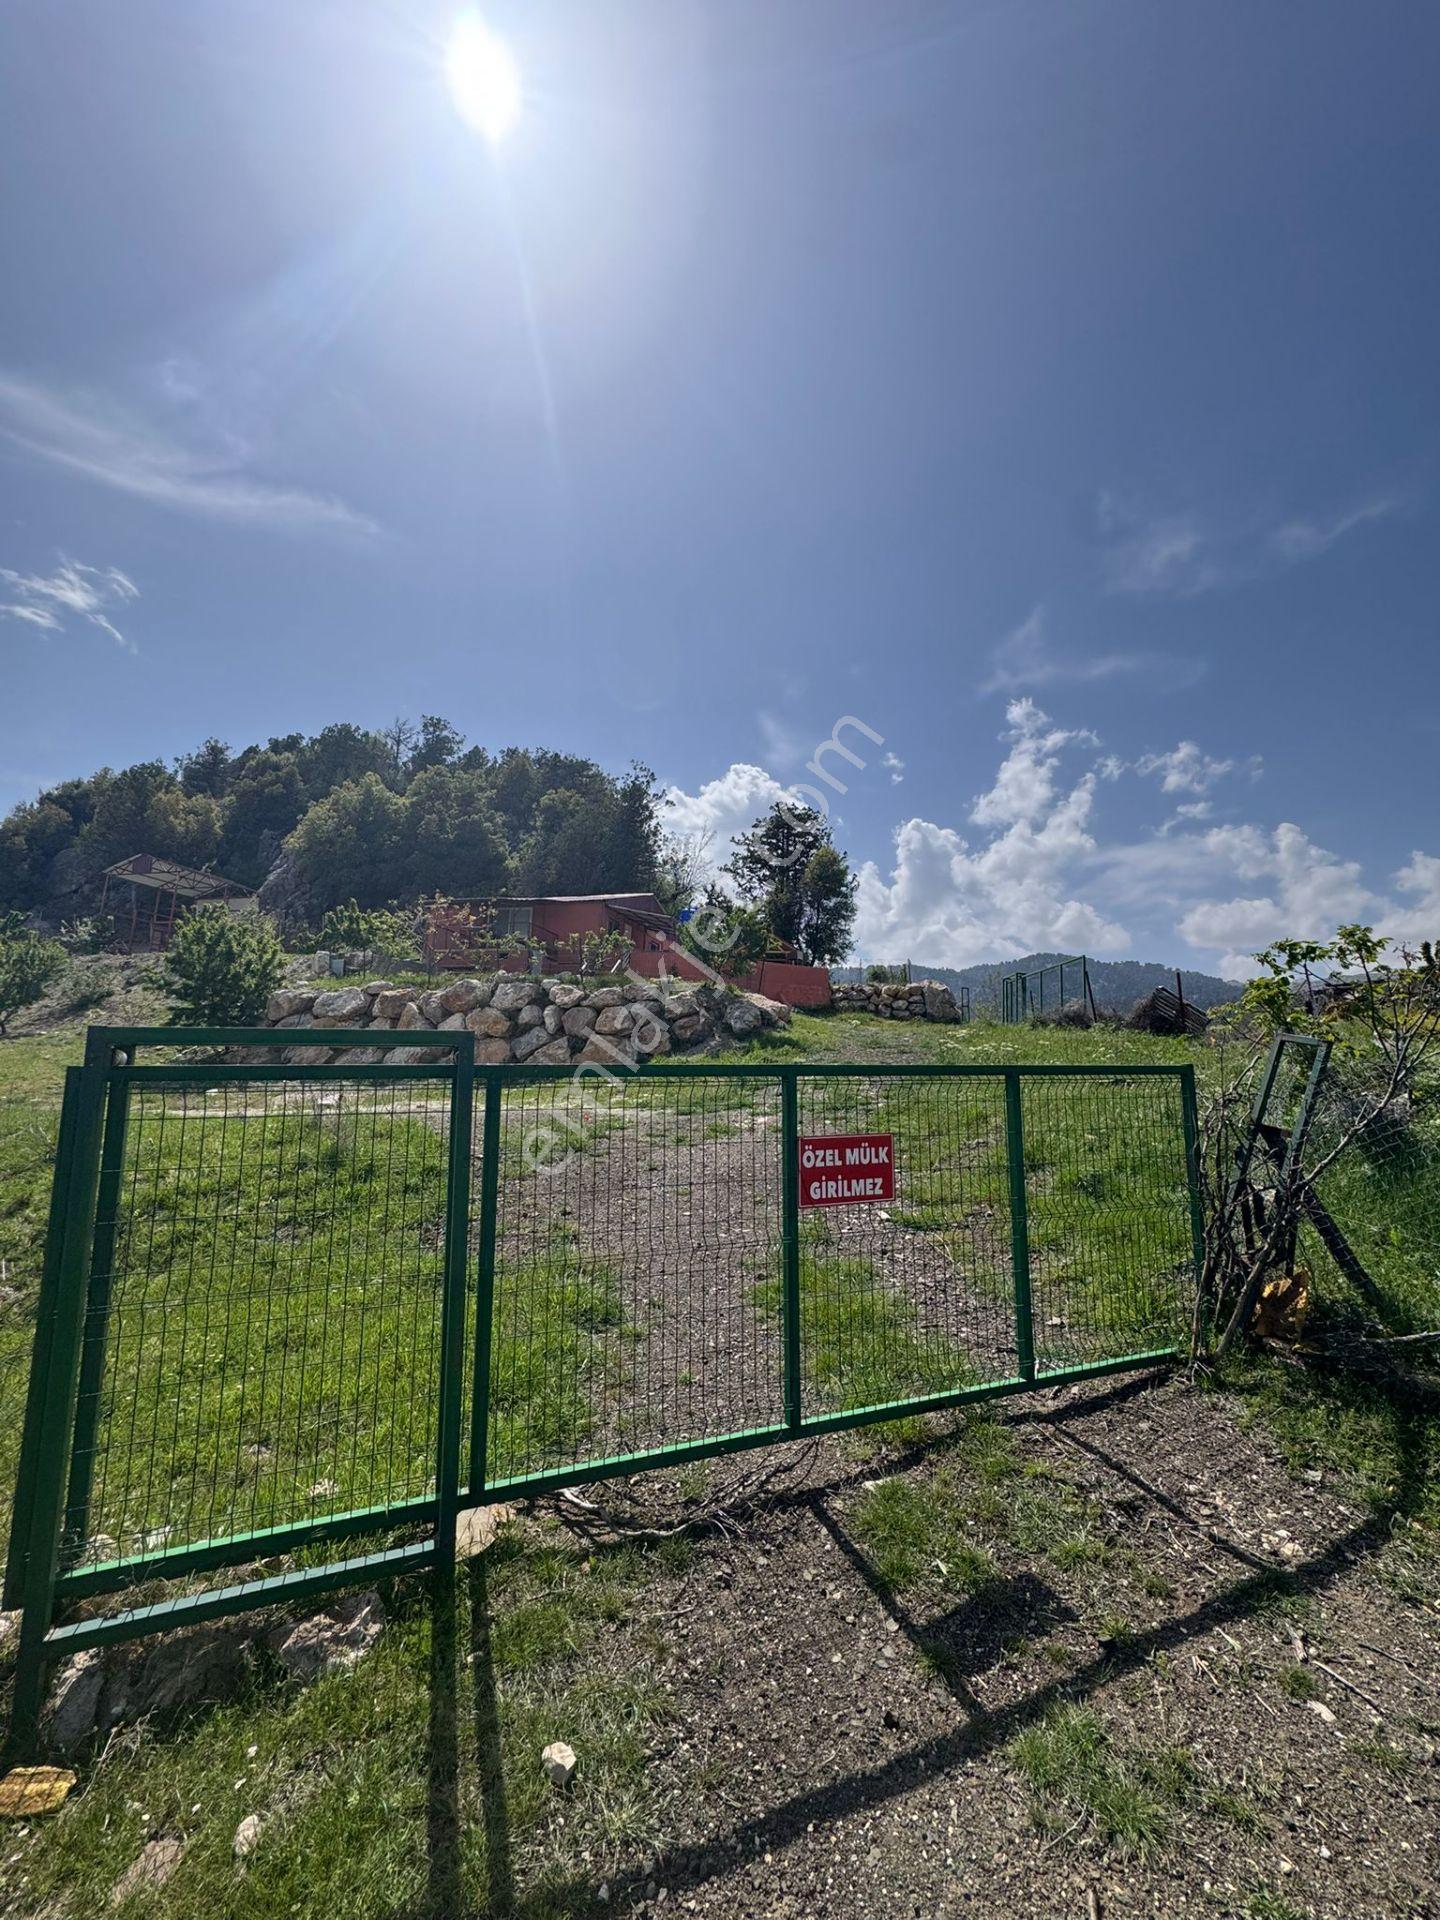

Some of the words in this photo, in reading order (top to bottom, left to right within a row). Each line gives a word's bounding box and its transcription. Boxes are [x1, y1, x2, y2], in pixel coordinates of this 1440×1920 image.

[802, 1145, 842, 1168] ÖZEL
[845, 1142, 889, 1165] MÜLK
[809, 1174, 883, 1199] GİRİLMEZ
